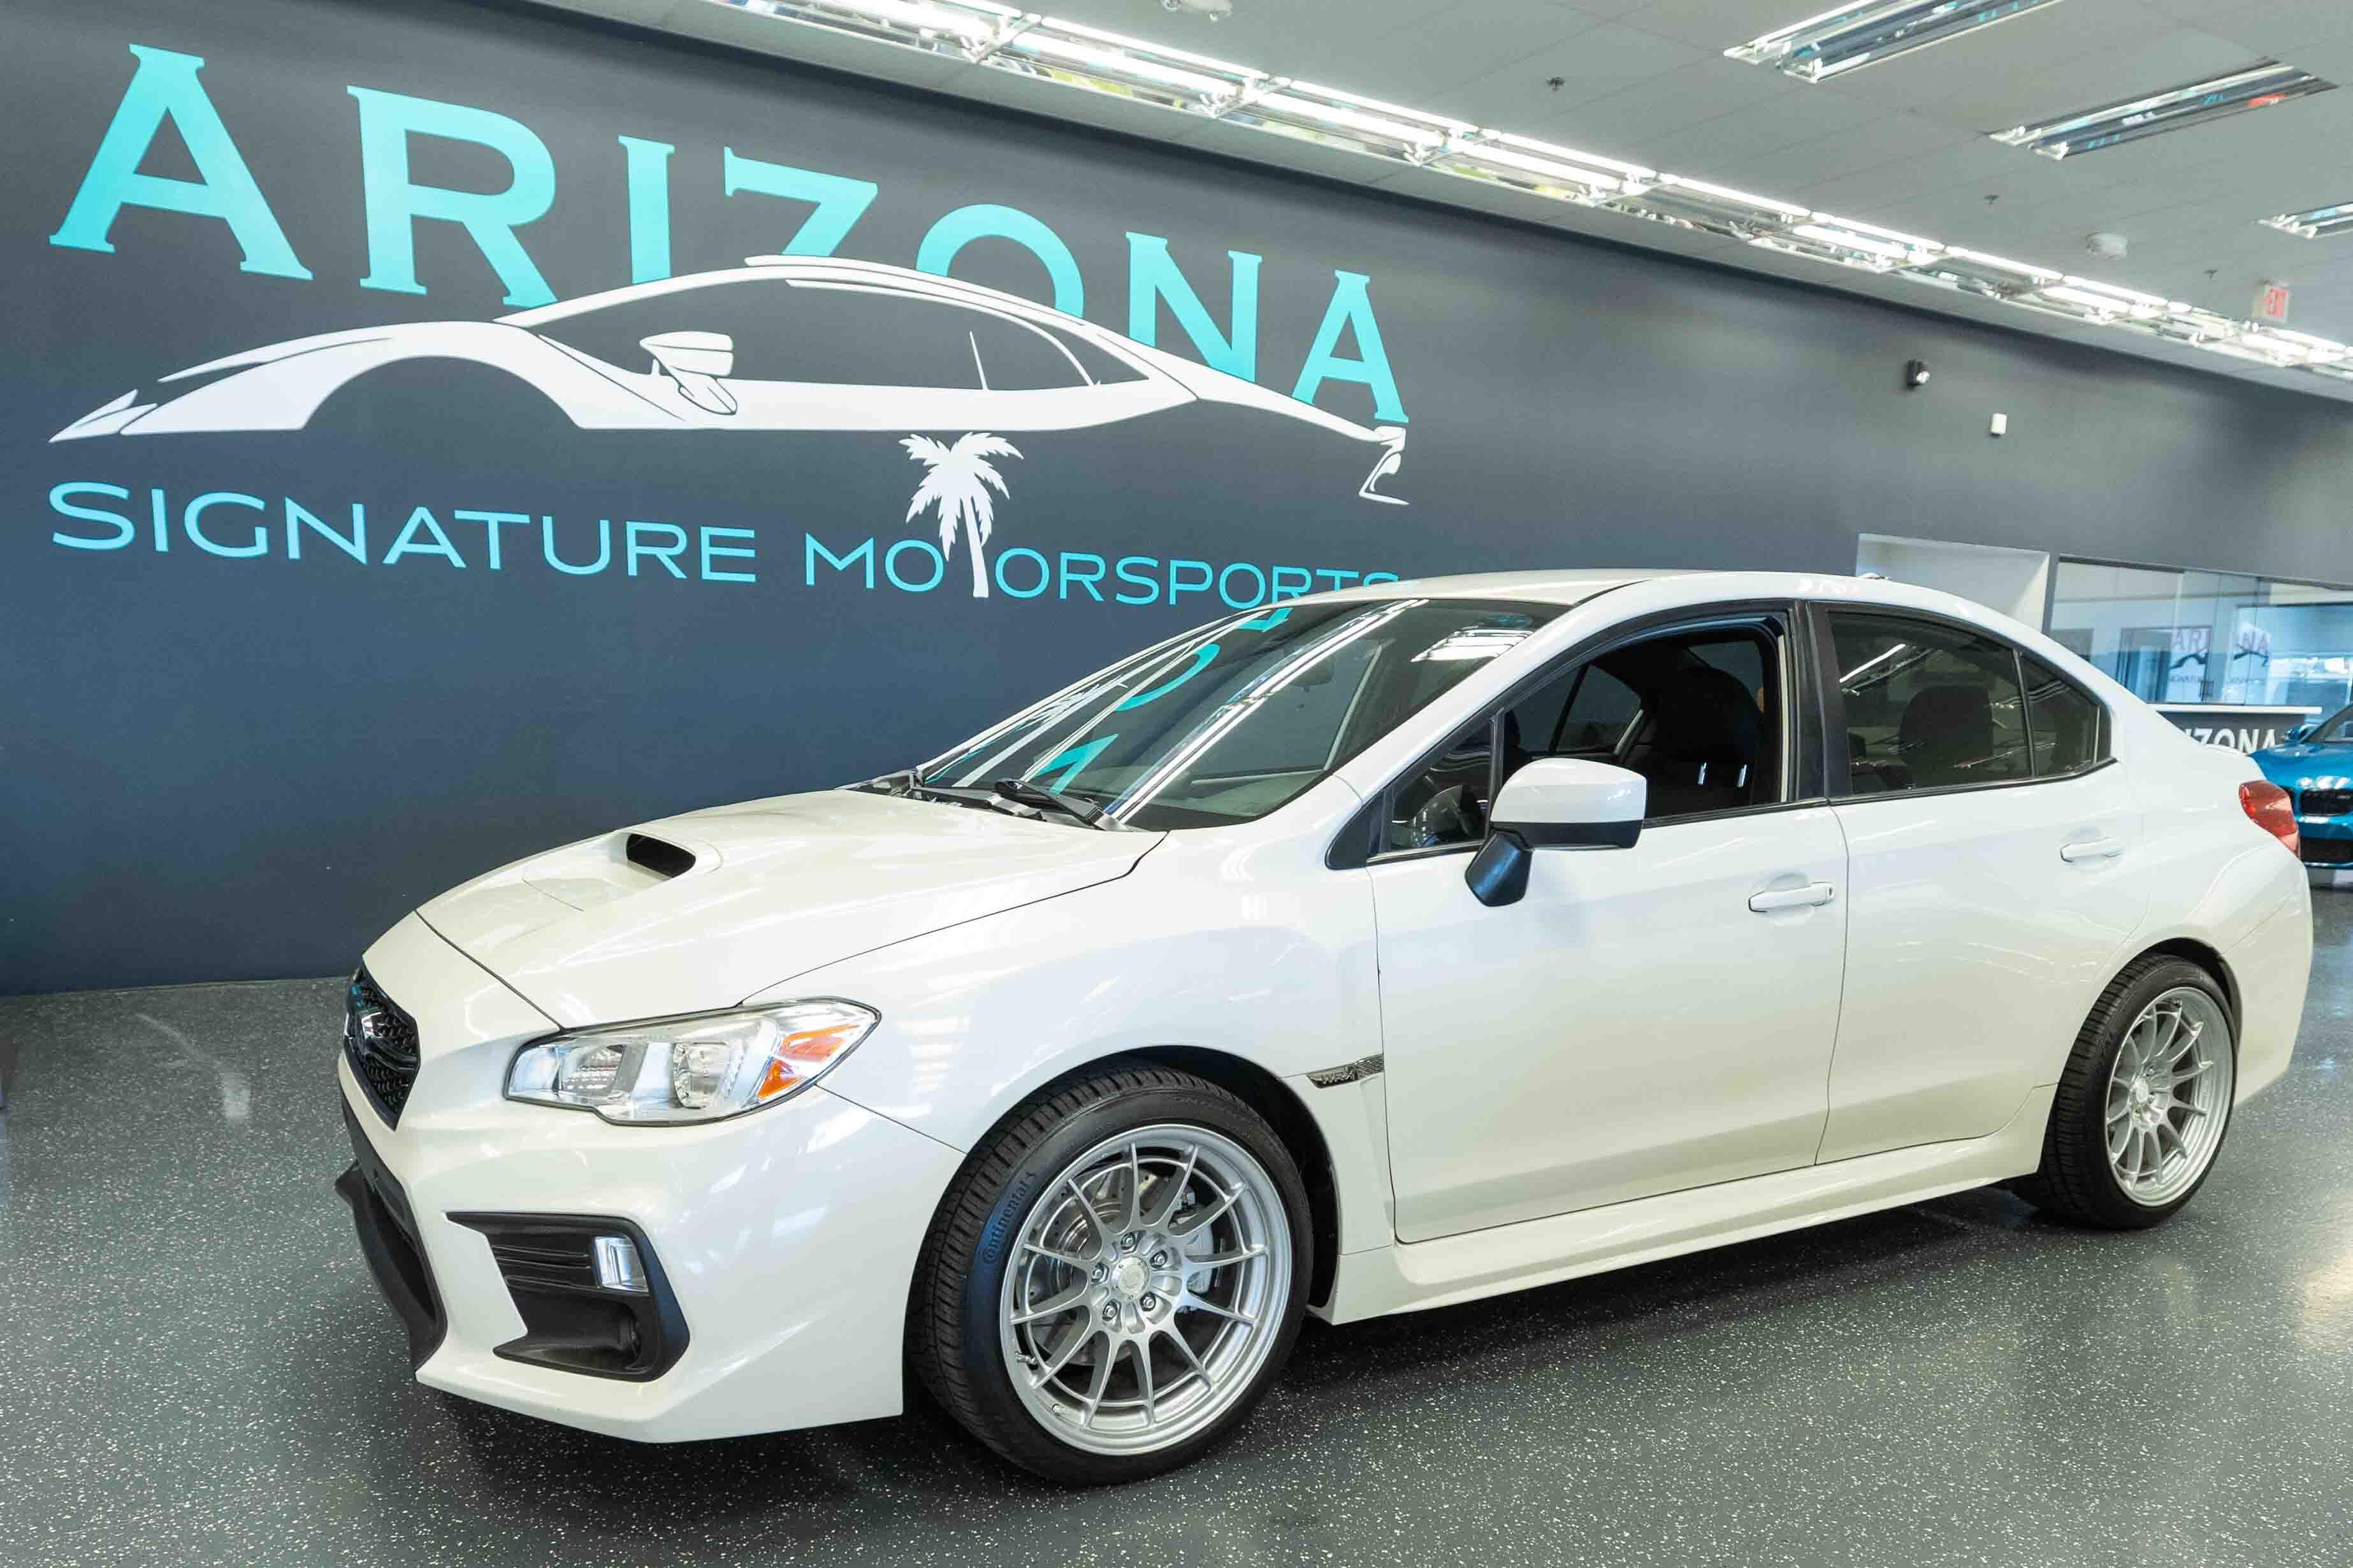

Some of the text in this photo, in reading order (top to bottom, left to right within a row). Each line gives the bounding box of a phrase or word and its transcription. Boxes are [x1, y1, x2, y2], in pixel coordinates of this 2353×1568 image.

[49, 43, 1409, 423] ARIZONA
[50, 482, 756, 582] SIGNATURE
[2185, 727, 2277, 754] ZONA
